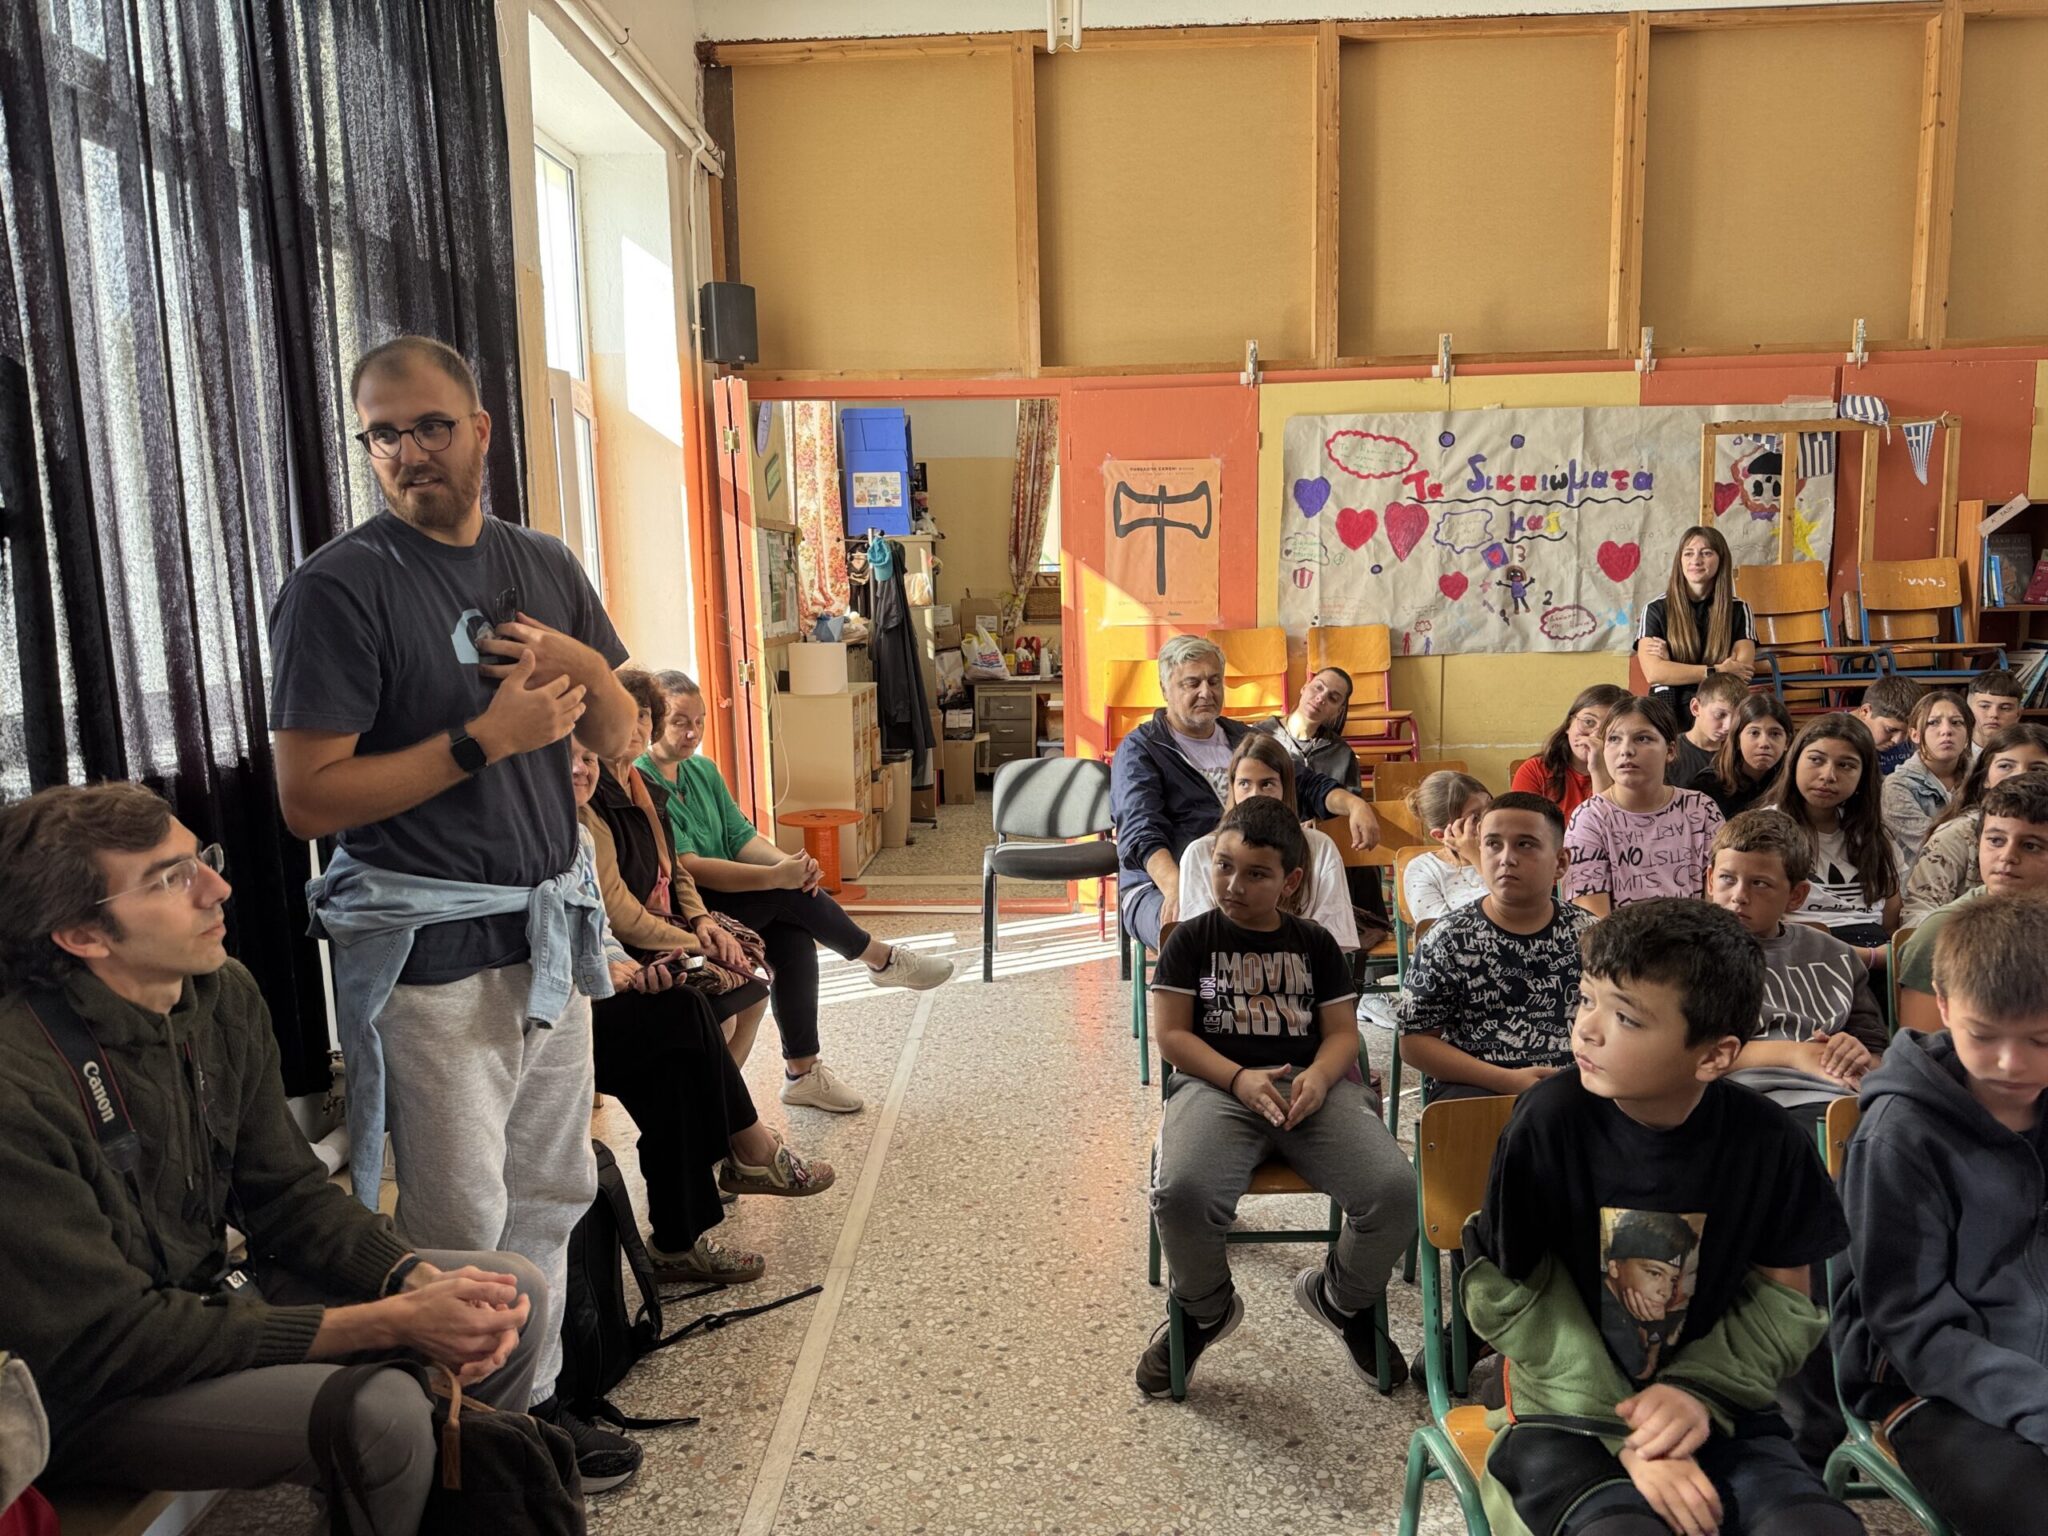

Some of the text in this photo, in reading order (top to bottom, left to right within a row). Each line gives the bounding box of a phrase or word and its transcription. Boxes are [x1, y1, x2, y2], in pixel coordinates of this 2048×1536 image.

[1402, 470, 1444, 500] Τα
[1217, 951, 1314, 995] MOVIN
[83, 1060, 116, 1124] Canon
